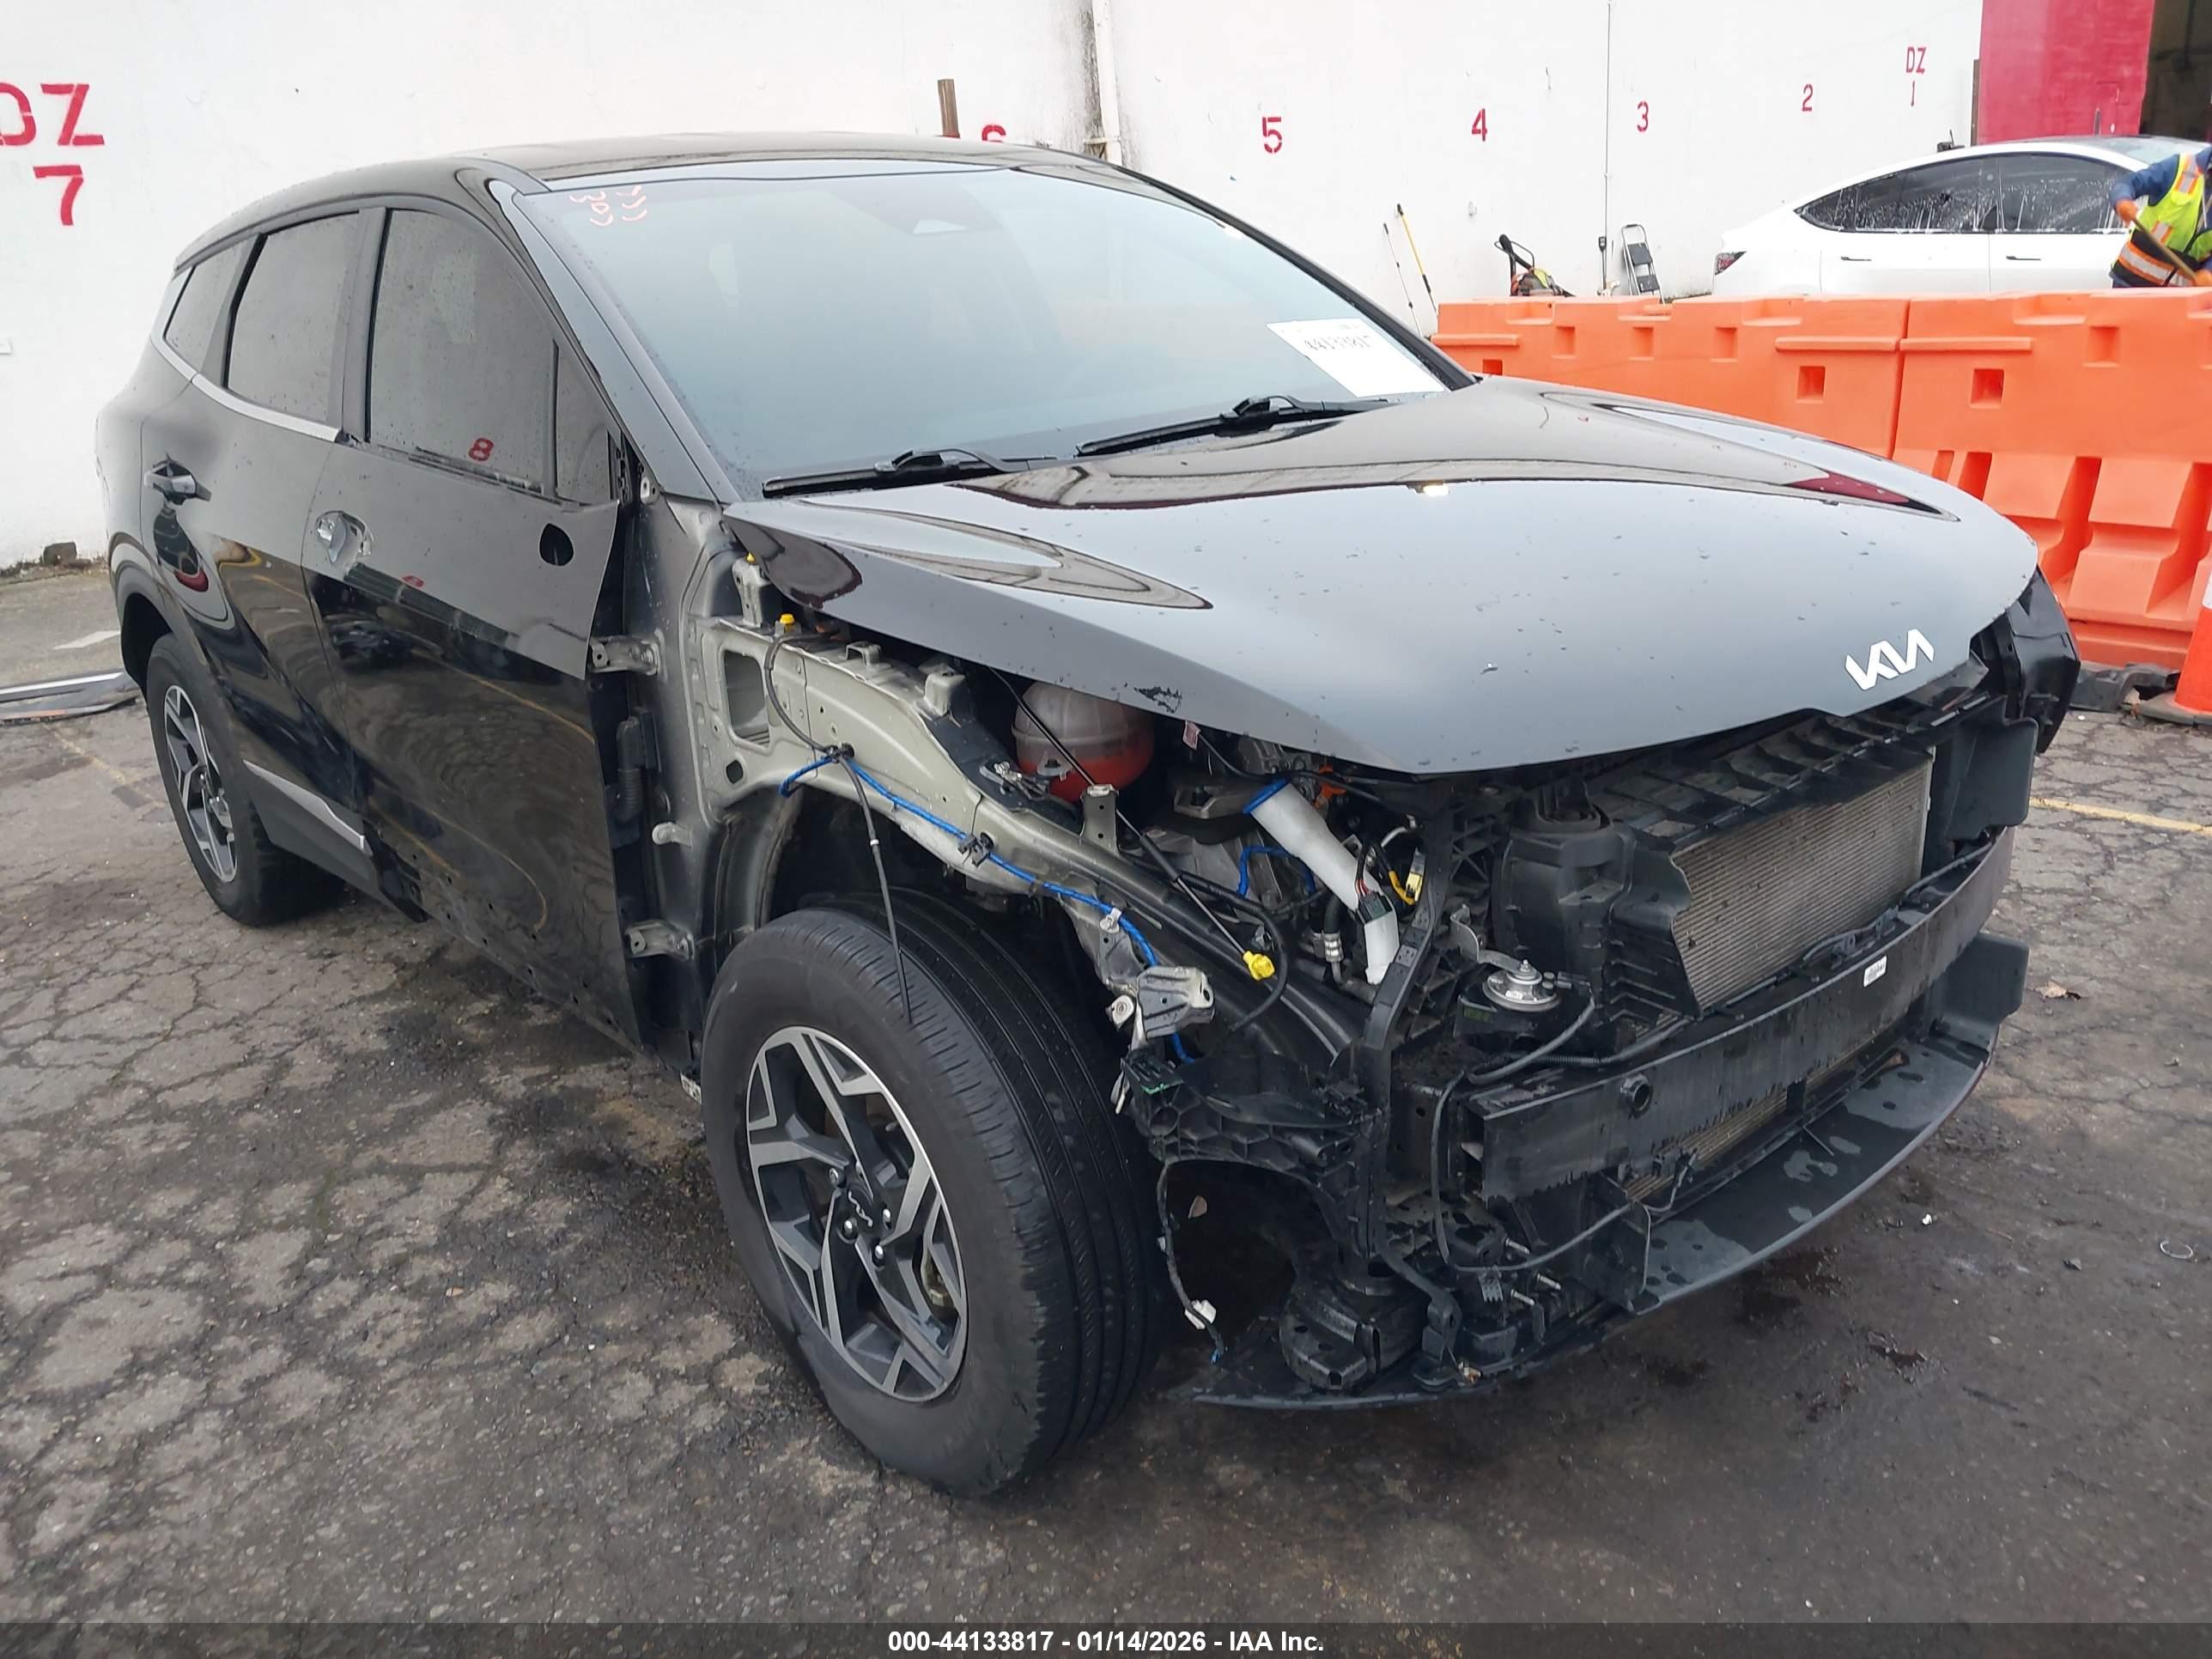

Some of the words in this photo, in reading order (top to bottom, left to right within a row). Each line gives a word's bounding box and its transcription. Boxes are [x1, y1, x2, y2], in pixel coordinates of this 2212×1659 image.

[1906, 46, 1926, 75] DZ
[1801, 85, 1814, 112] 2
[1471, 108, 1488, 142] 4
[1637, 100, 1650, 133] 3
[1261, 116, 1283, 154] 5
[33, 164, 85, 228] 7
